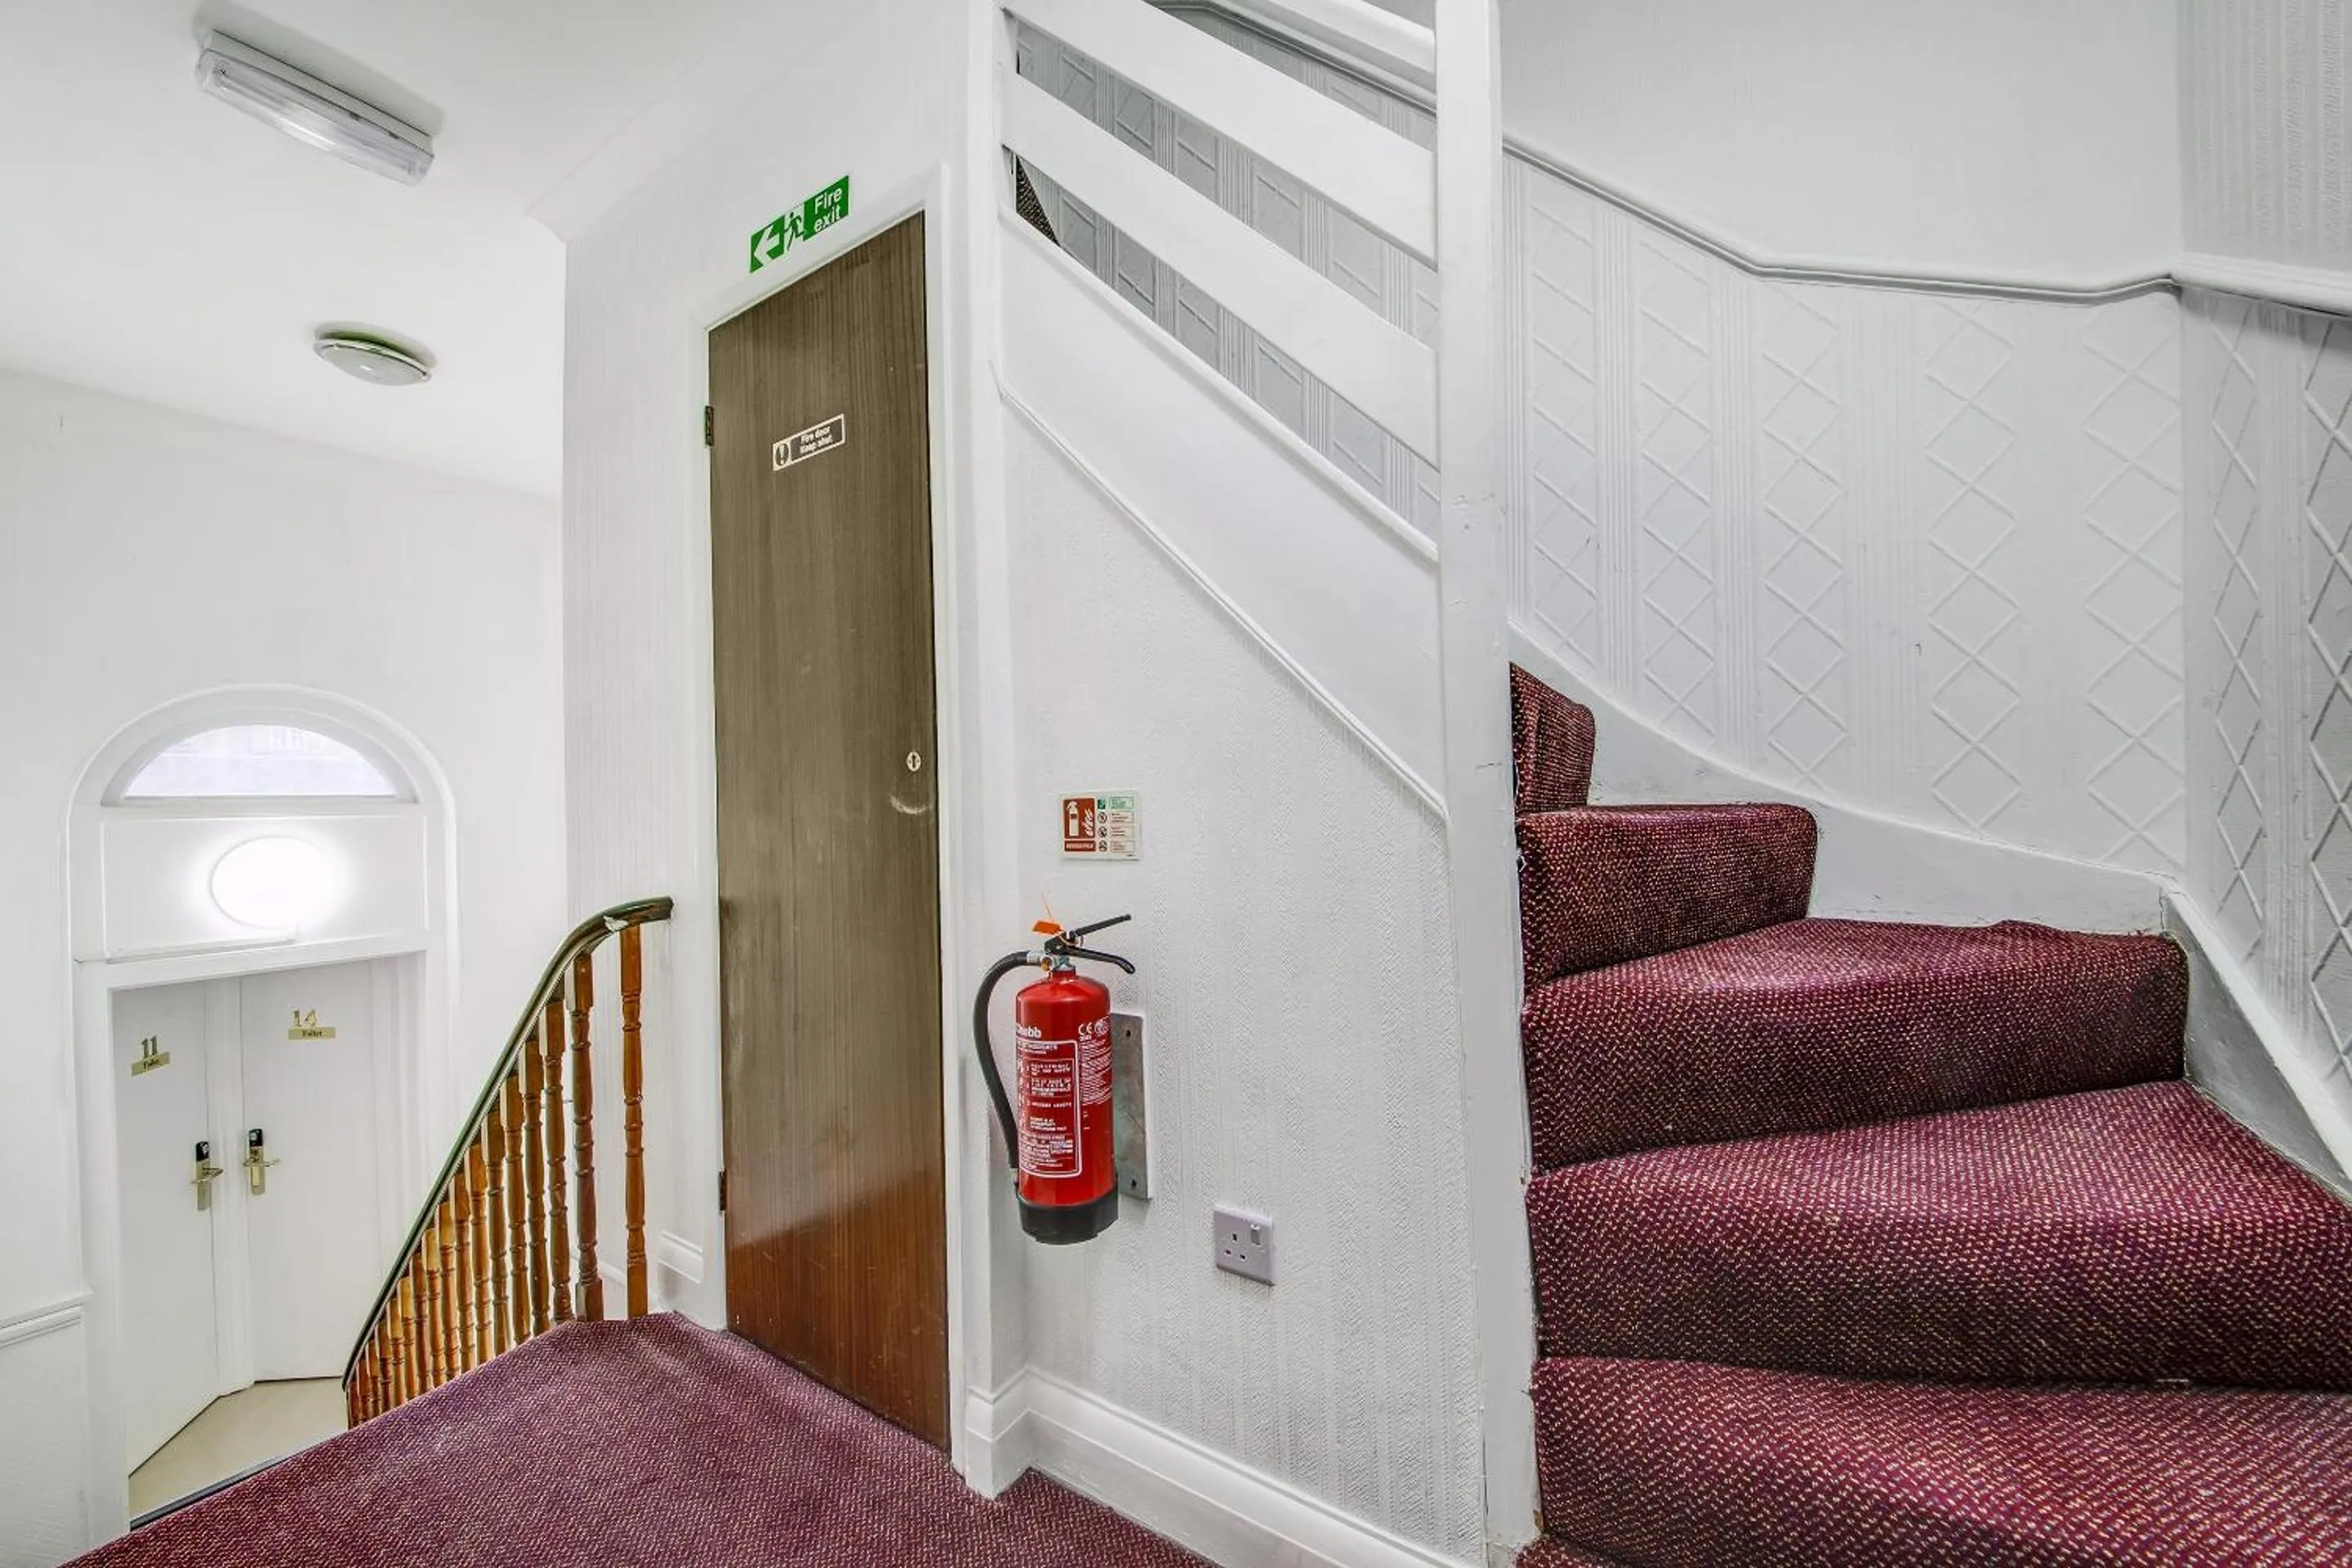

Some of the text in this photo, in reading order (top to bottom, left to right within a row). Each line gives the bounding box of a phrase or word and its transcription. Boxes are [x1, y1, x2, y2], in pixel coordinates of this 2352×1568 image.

[815, 187, 843, 215] Fire
[814, 205, 842, 232] exit
[292, 1009, 317, 1027] 14
[140, 1036, 158, 1058] 11
